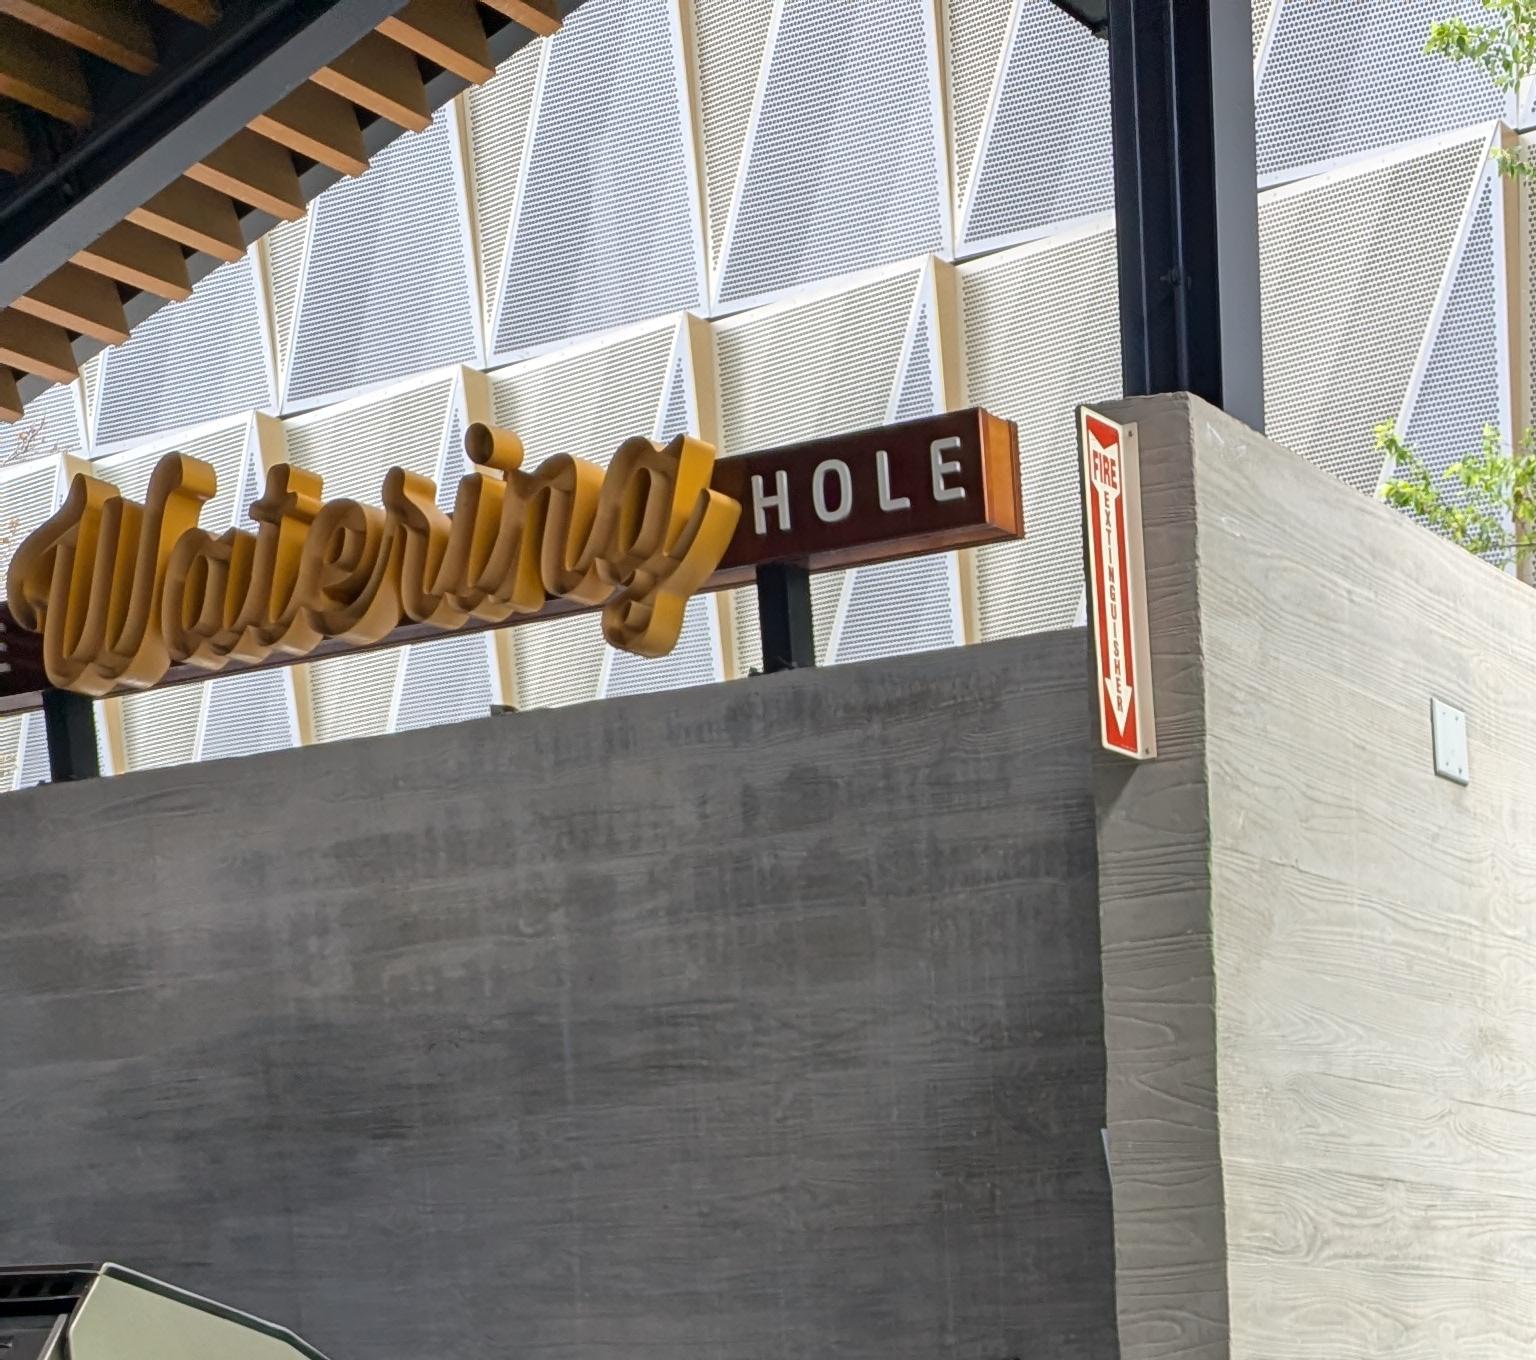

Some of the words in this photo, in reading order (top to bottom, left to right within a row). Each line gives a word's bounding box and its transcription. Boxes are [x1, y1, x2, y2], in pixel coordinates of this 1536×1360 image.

[8, 422, 741, 697] Watering
[751, 436, 966, 535] HOLE
[1092, 449, 1118, 490] FIRE
[1103, 490, 1124, 713] EXTINGUISHER
